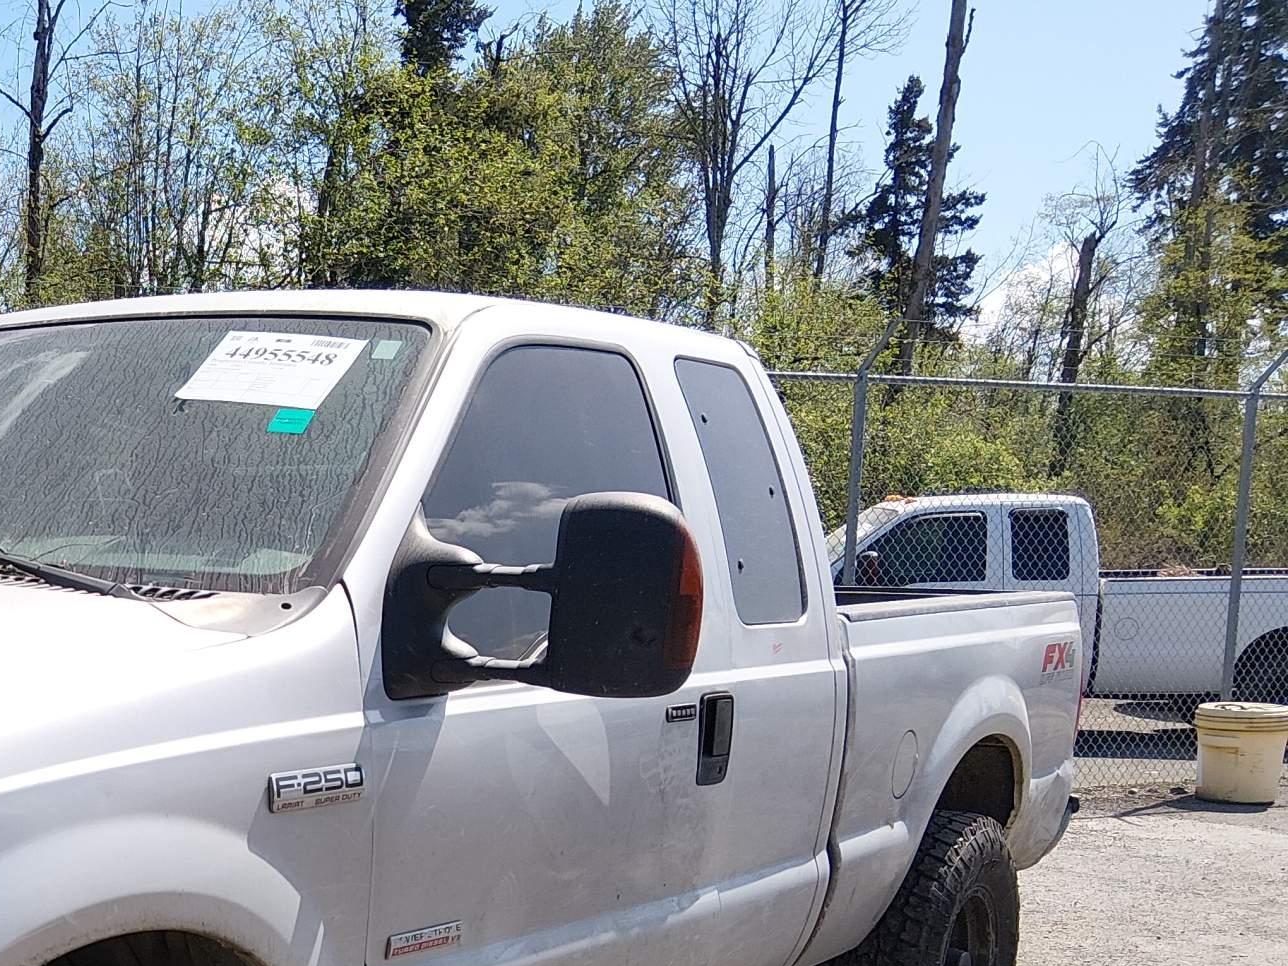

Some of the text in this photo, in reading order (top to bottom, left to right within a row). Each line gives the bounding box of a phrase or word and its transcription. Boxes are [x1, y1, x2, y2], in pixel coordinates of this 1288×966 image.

[225, 346, 338, 366] 44955548
[1041, 641, 1077, 672] FX4
[277, 791, 362, 811] LARIAT SUPER DUTY
